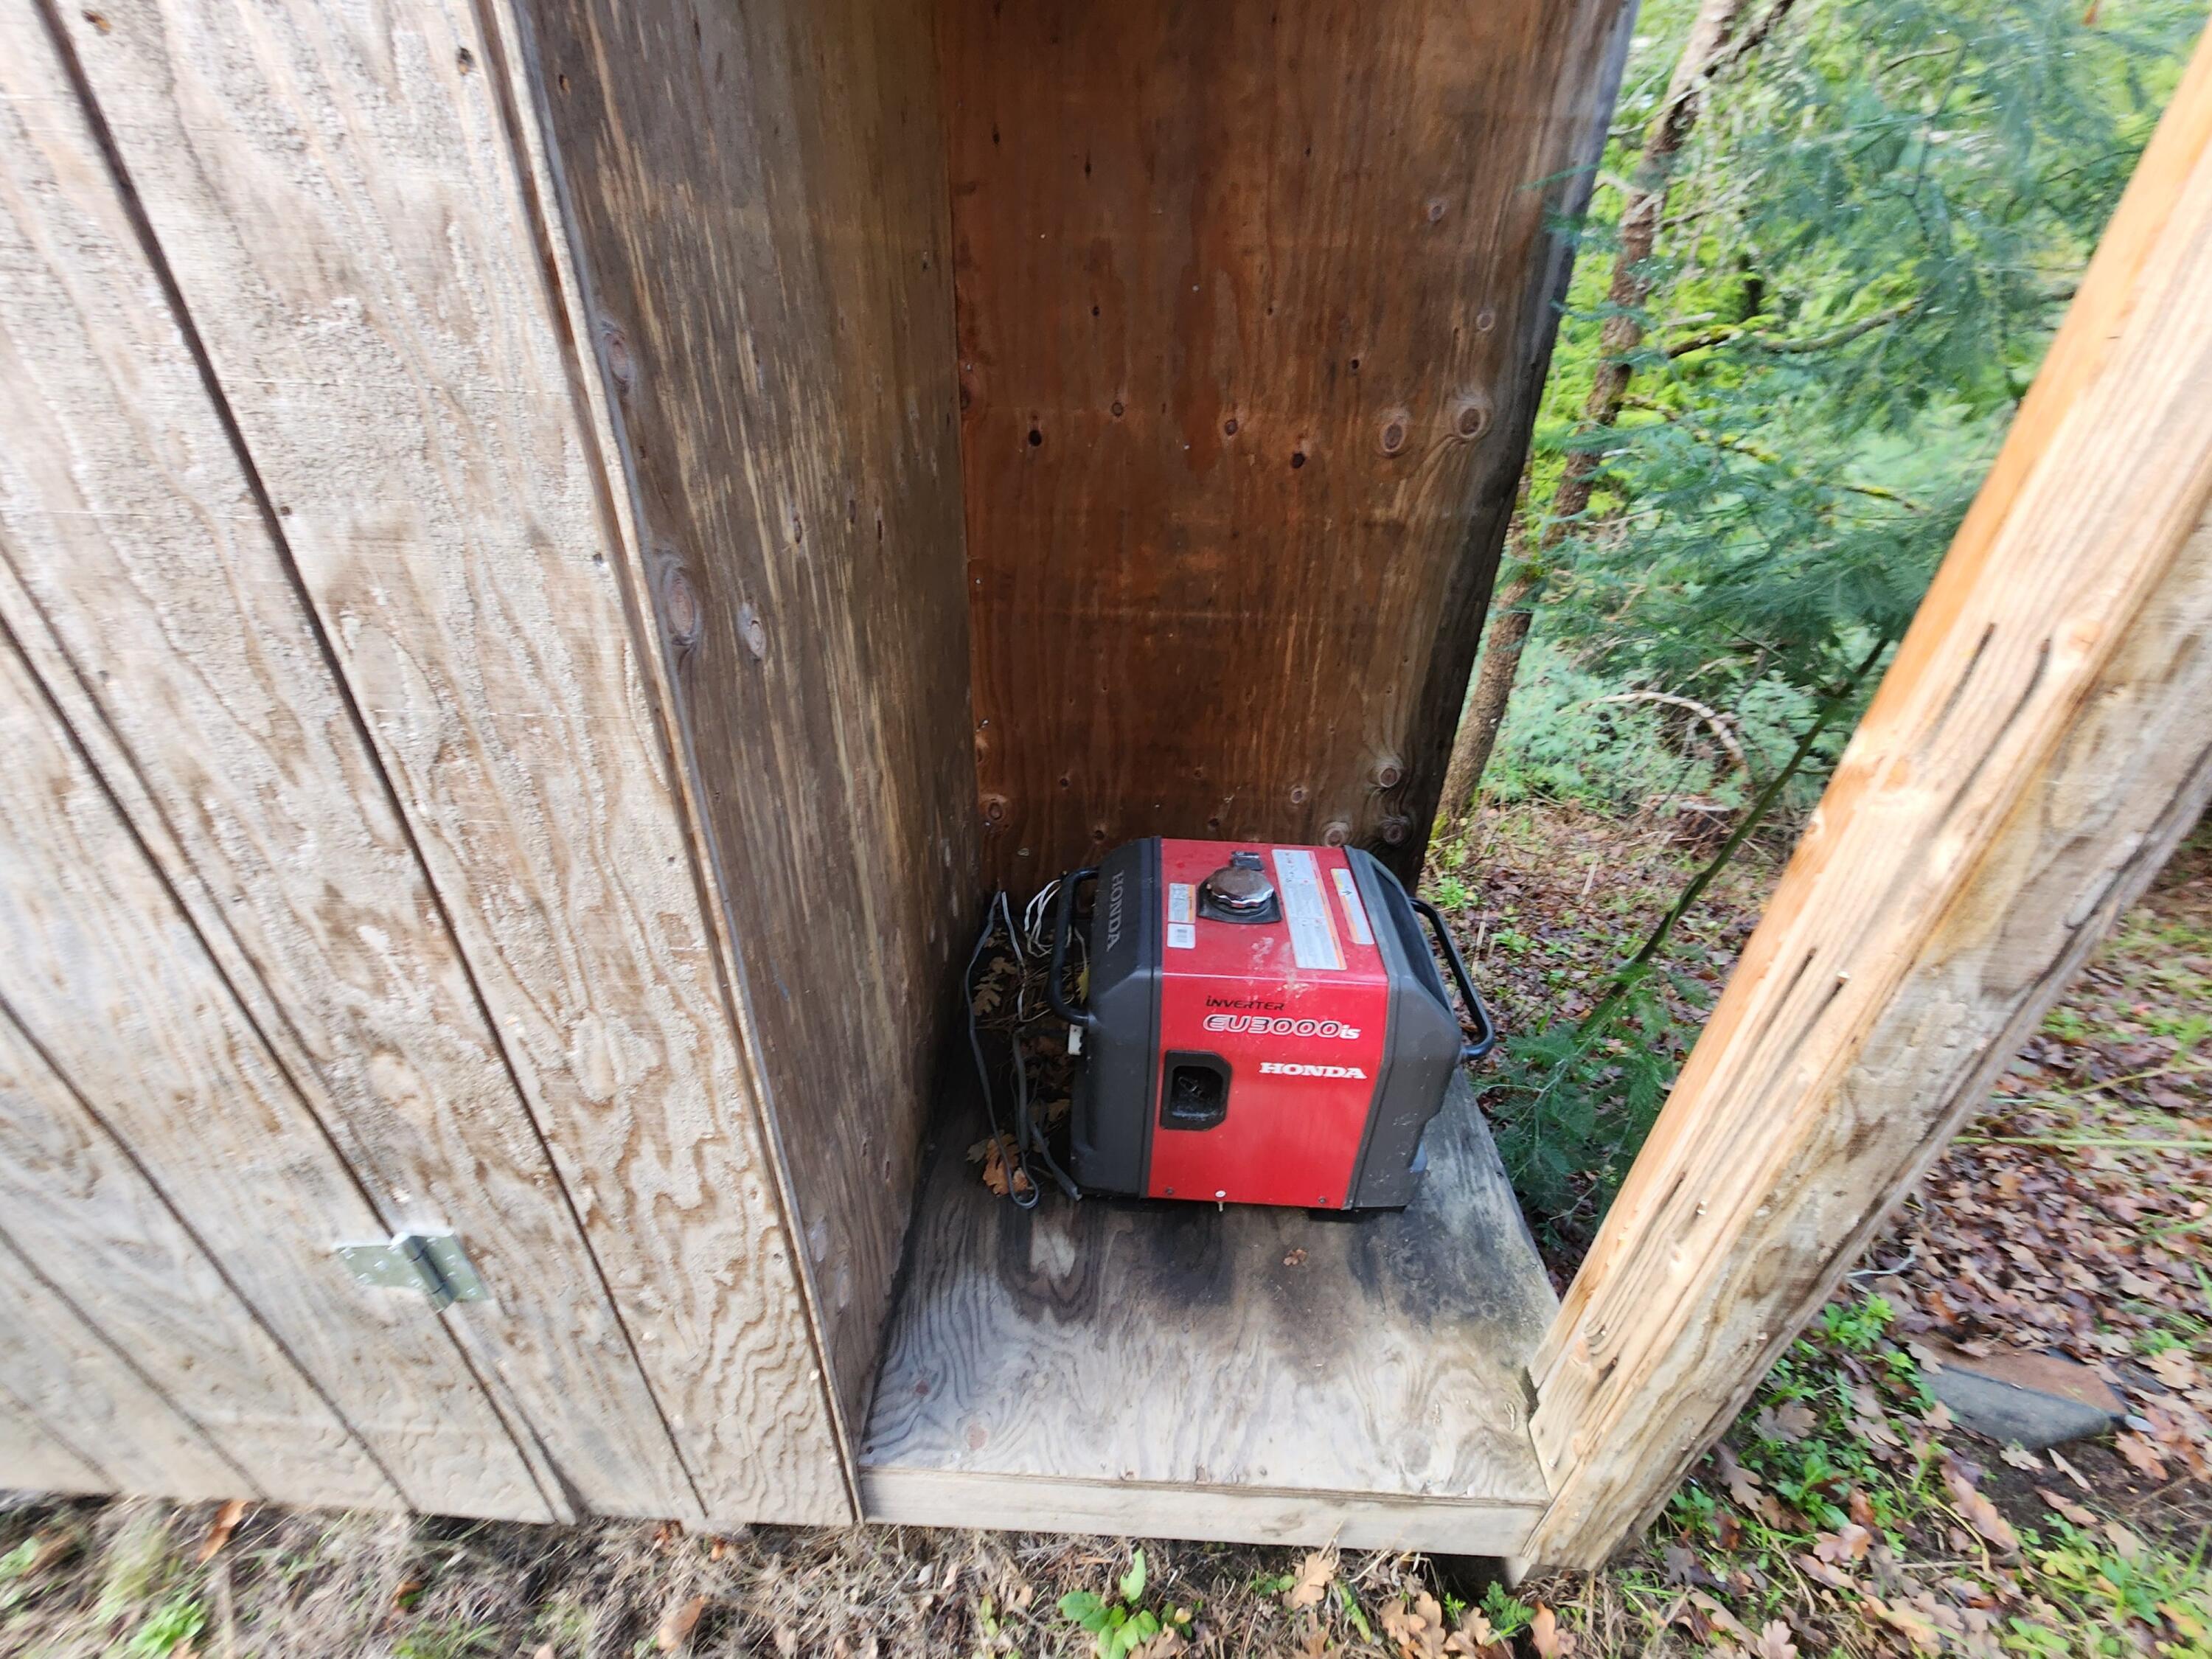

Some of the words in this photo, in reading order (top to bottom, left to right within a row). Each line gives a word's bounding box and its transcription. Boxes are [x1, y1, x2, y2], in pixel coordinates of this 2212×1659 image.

[1106, 869, 1124, 952] HONDA
[1203, 1014, 1361, 1040] EU3000is
[1259, 1062, 1367, 1079] HONDA
